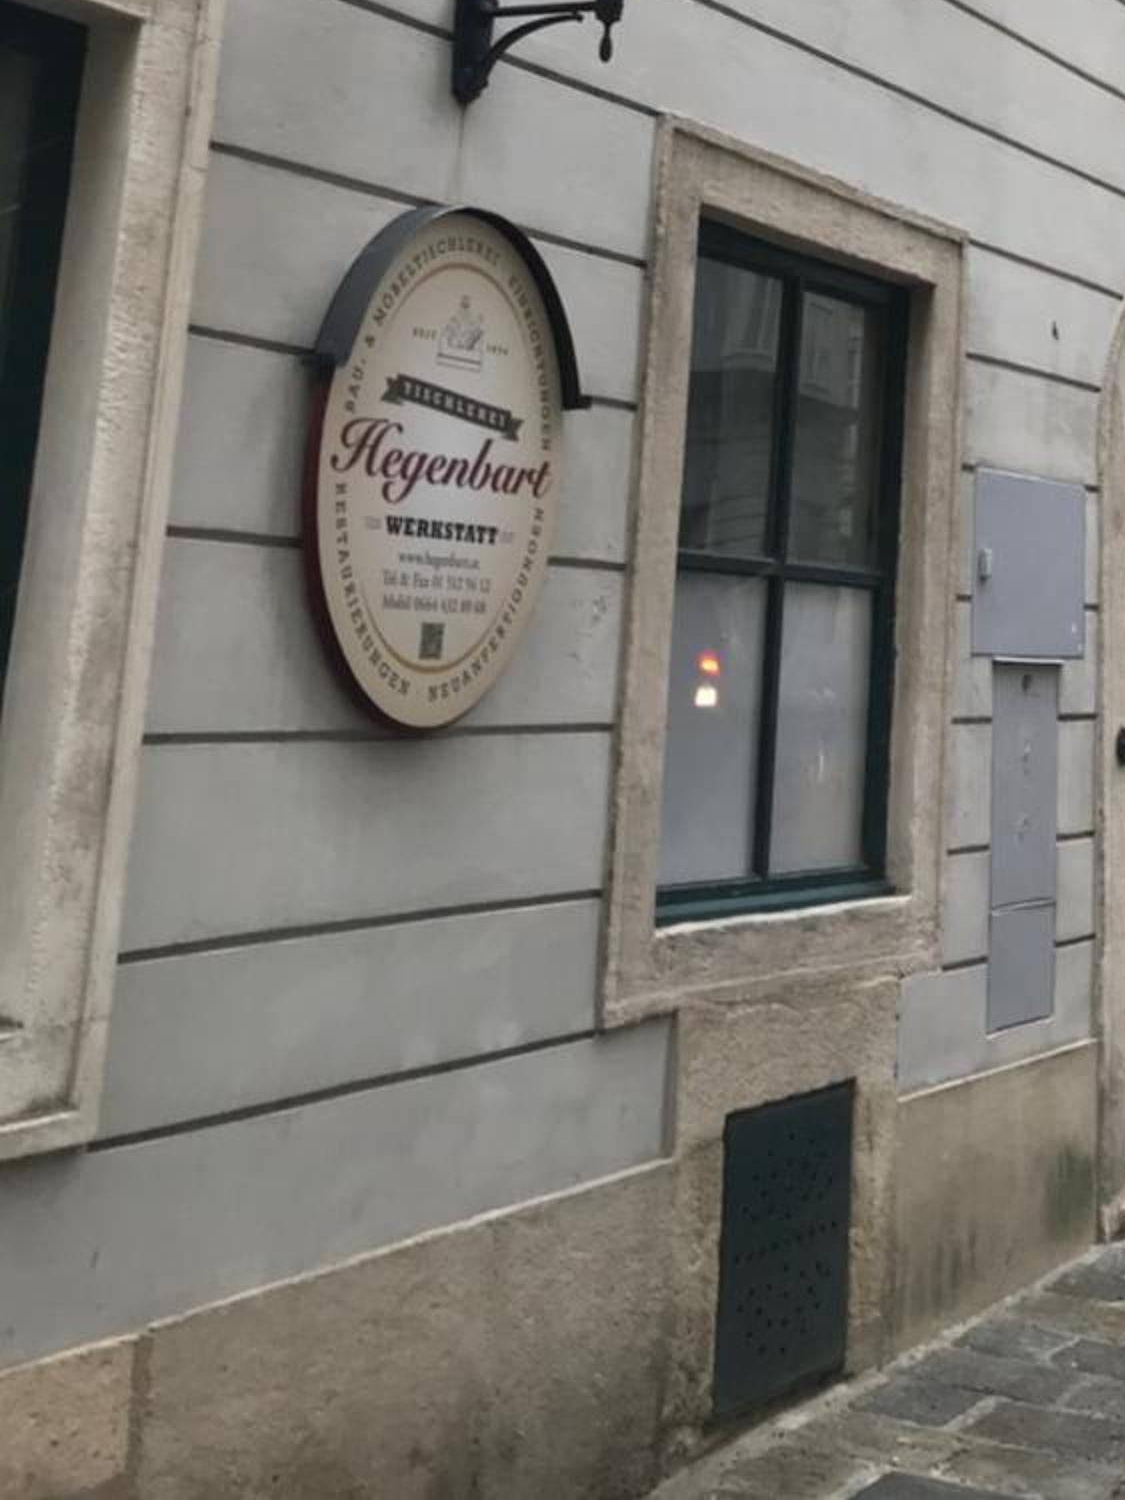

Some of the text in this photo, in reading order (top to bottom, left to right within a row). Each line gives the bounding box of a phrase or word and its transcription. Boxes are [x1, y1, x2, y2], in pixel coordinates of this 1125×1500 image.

[403, 380, 507, 428] TISCHLEREI
[330, 416, 556, 504] Hegenbart
[385, 514, 499, 545] WERKSTATT
[335, 483, 411, 697] RESTAURIERUNGEN
